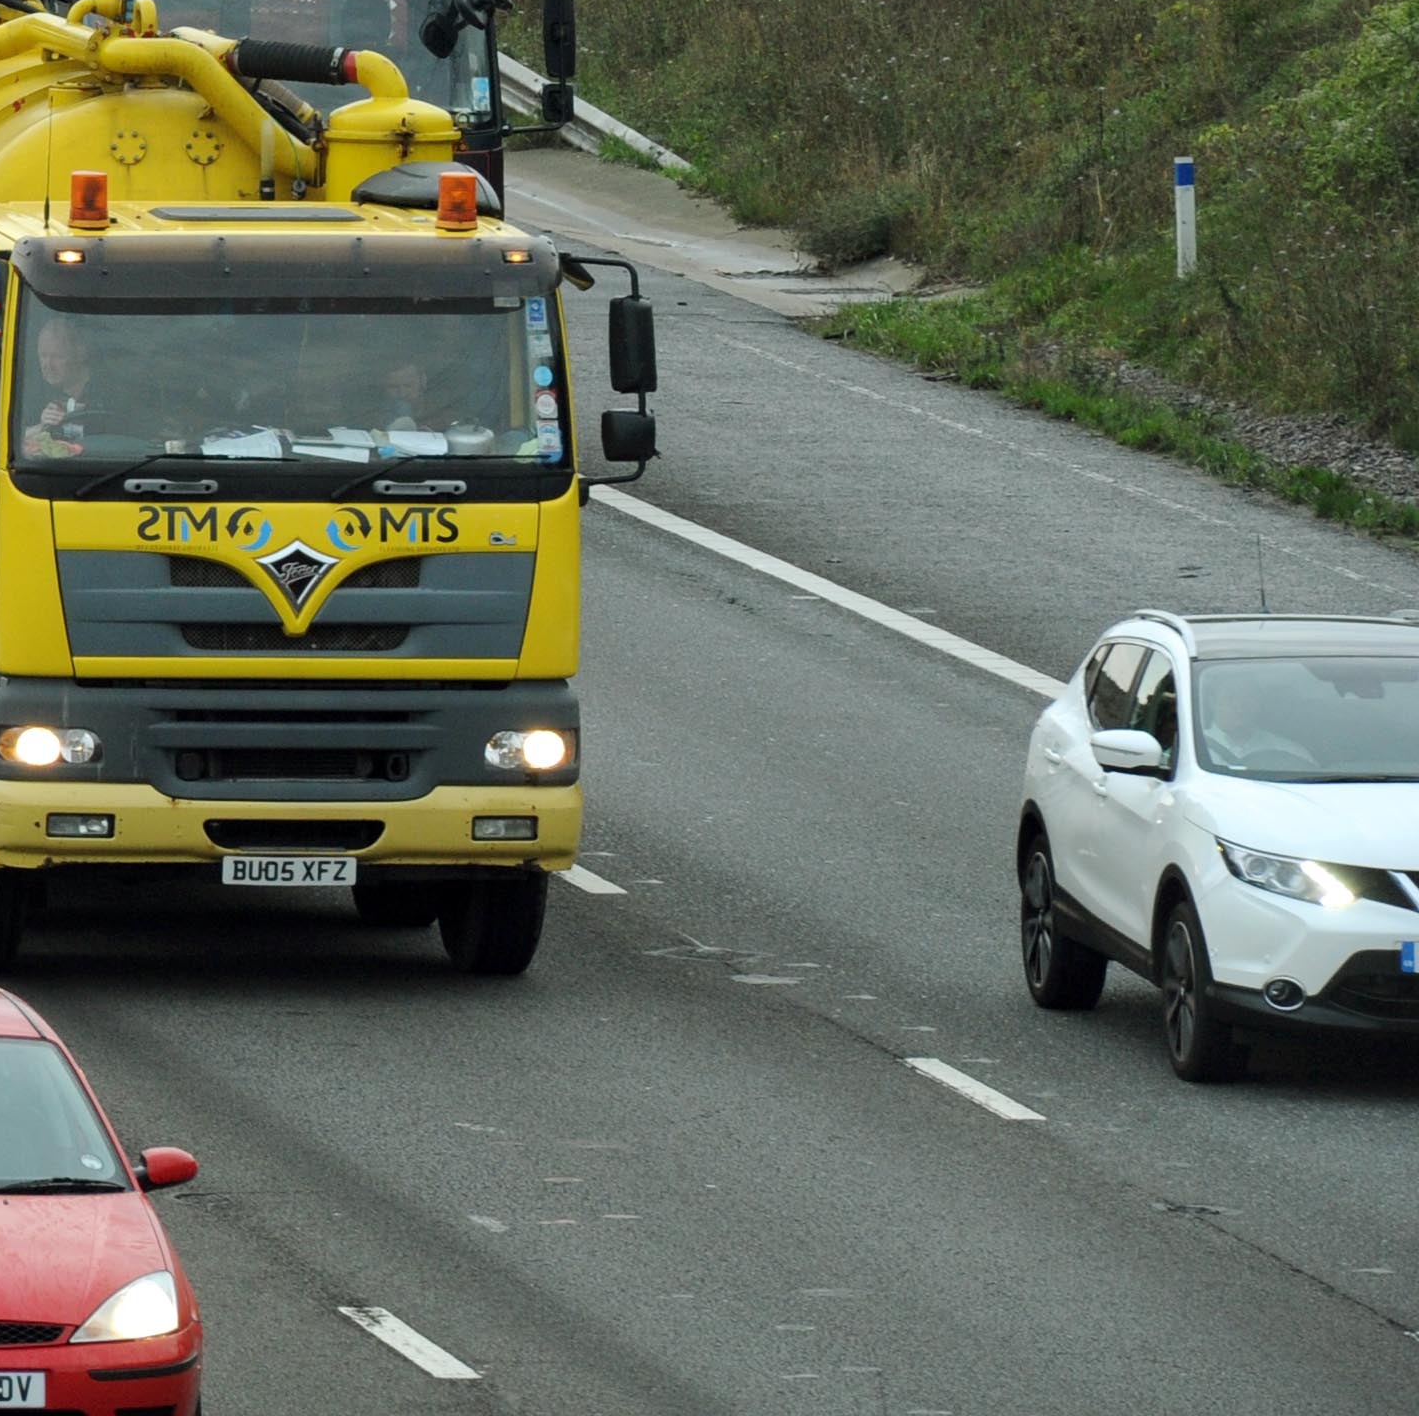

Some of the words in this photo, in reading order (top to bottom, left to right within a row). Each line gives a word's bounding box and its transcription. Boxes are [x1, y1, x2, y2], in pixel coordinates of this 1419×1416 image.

[379, 506, 460, 543] MTS
[233, 860, 294, 881] BU05
[302, 861, 347, 881] XFZ
